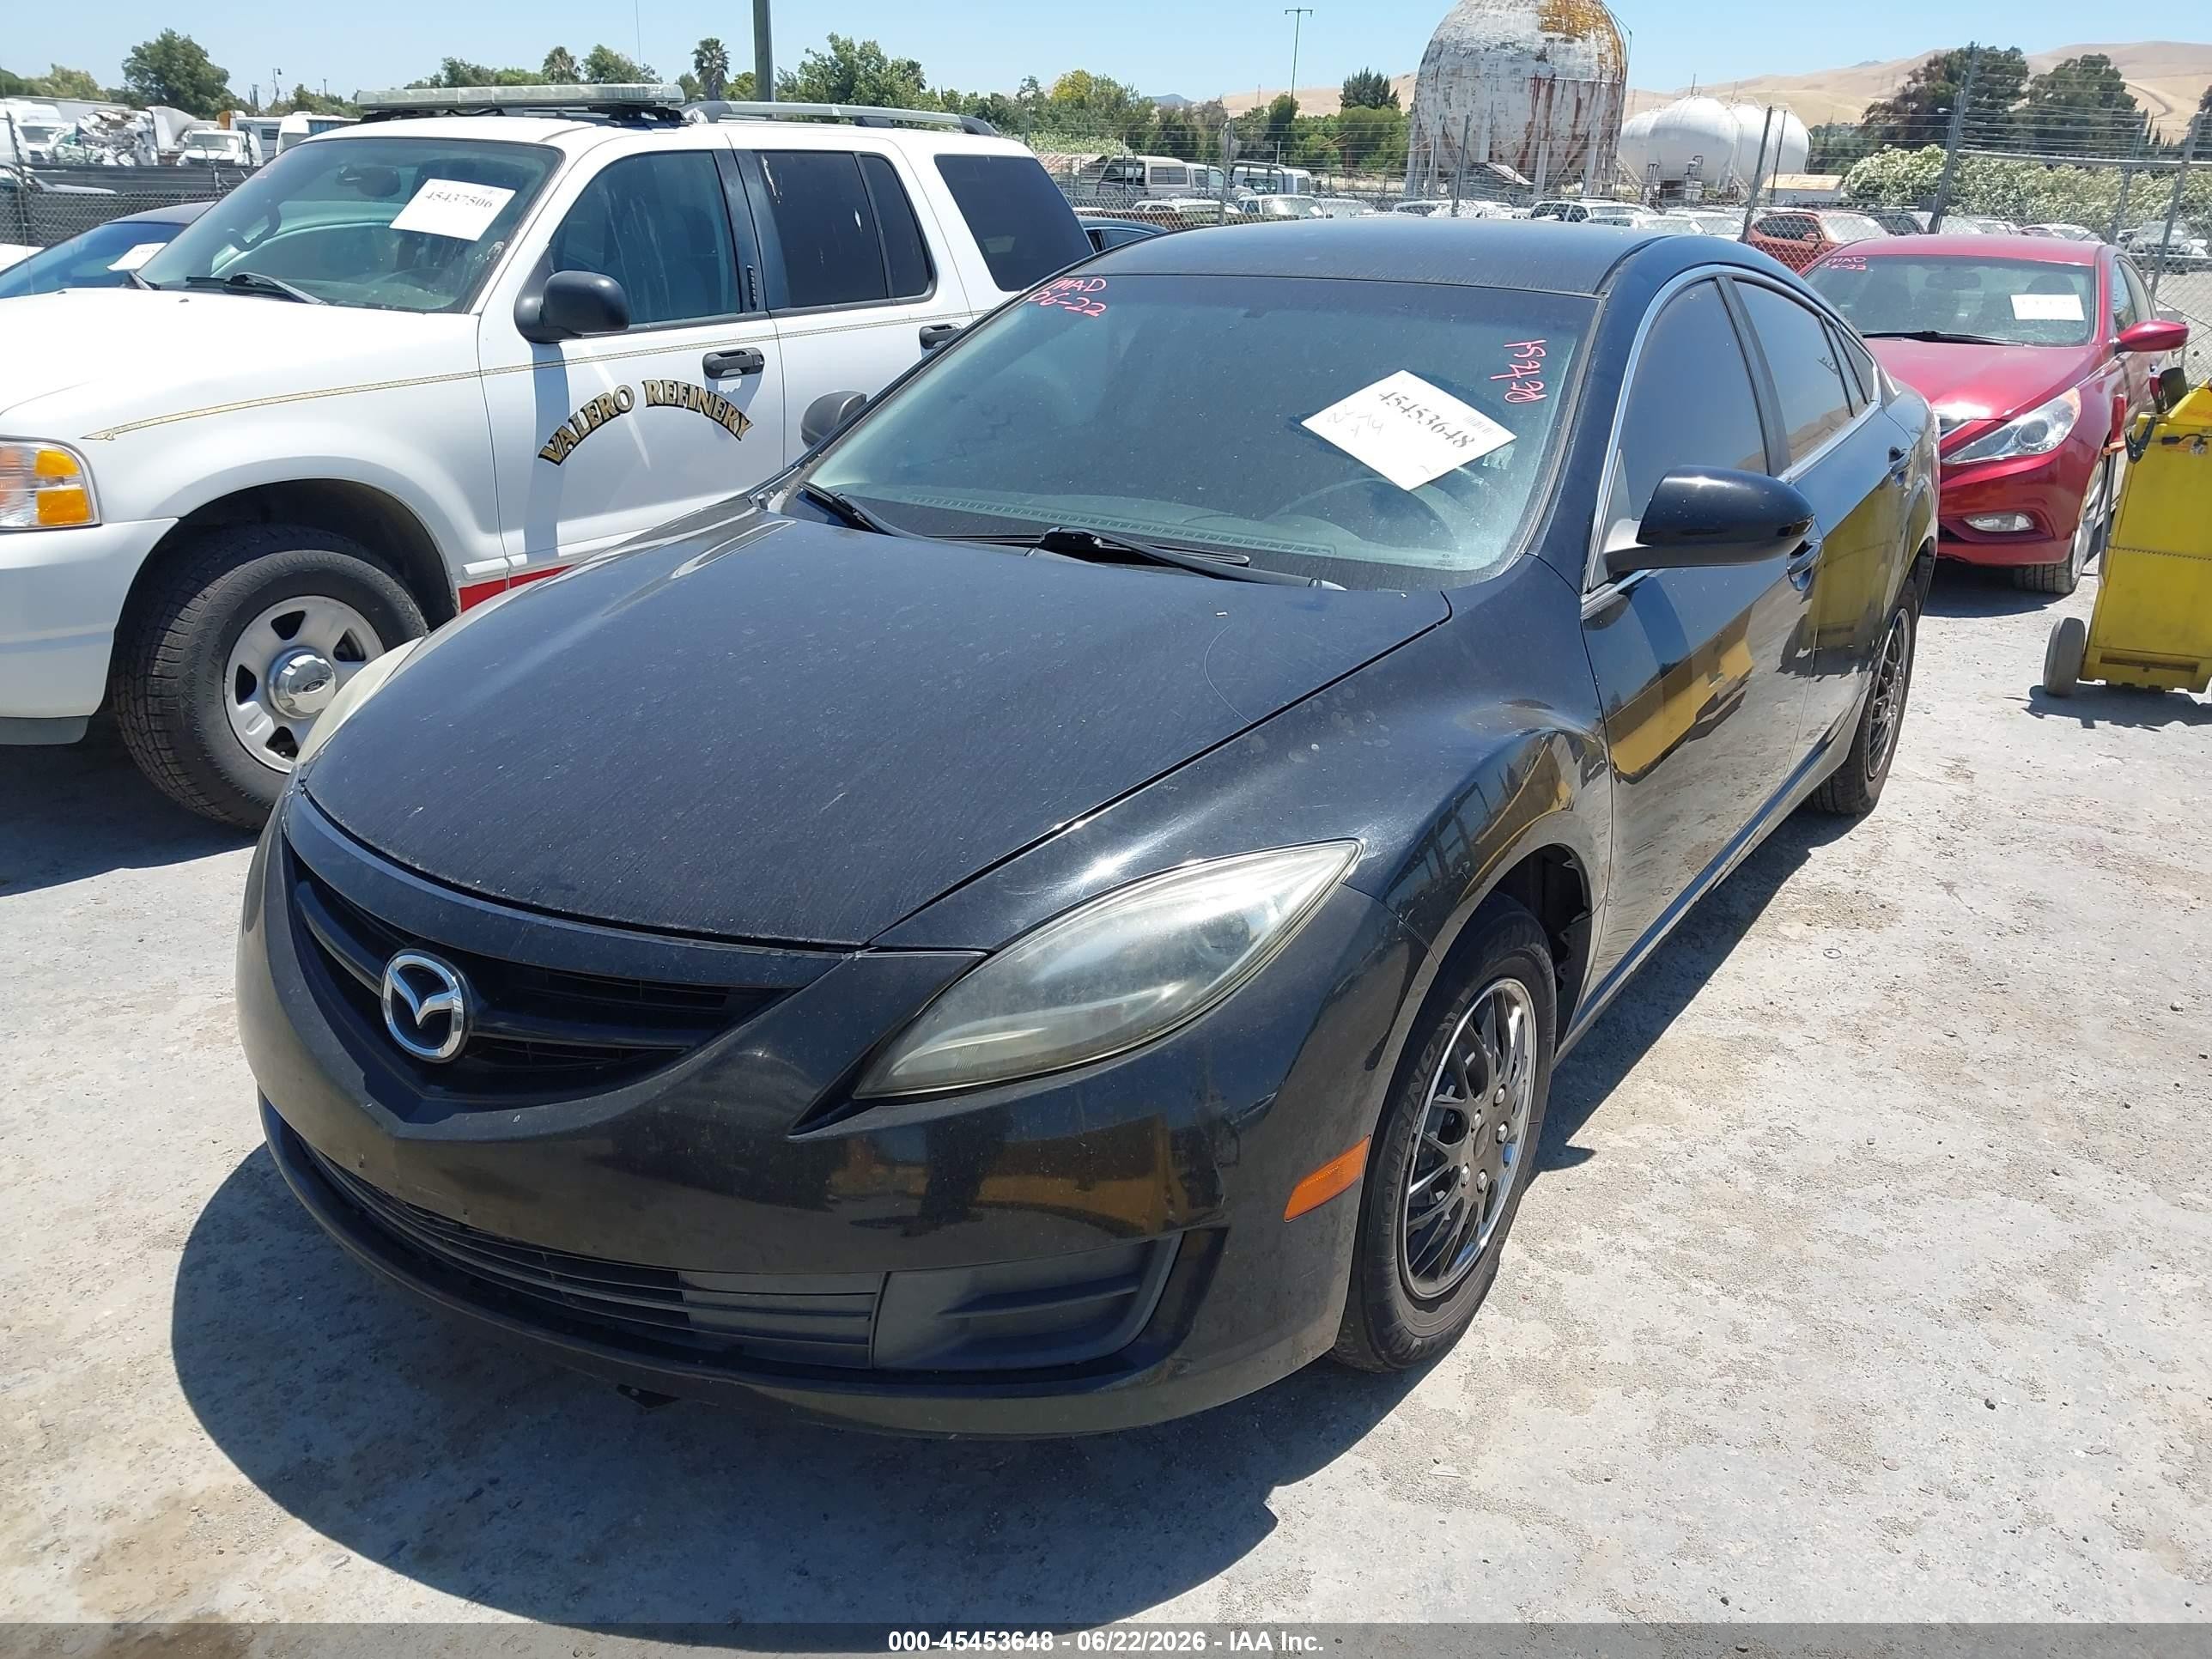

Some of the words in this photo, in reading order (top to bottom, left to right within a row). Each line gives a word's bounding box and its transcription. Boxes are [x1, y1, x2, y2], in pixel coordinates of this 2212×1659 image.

[426, 191, 493, 209] 45437506
[1043, 277, 1107, 292] MAD
[1030, 290, 1107, 318] 06-22
[538, 384, 635, 466] VALERO
[641, 379, 754, 441] REFINERY
[1378, 392, 1475, 448] 45453648
